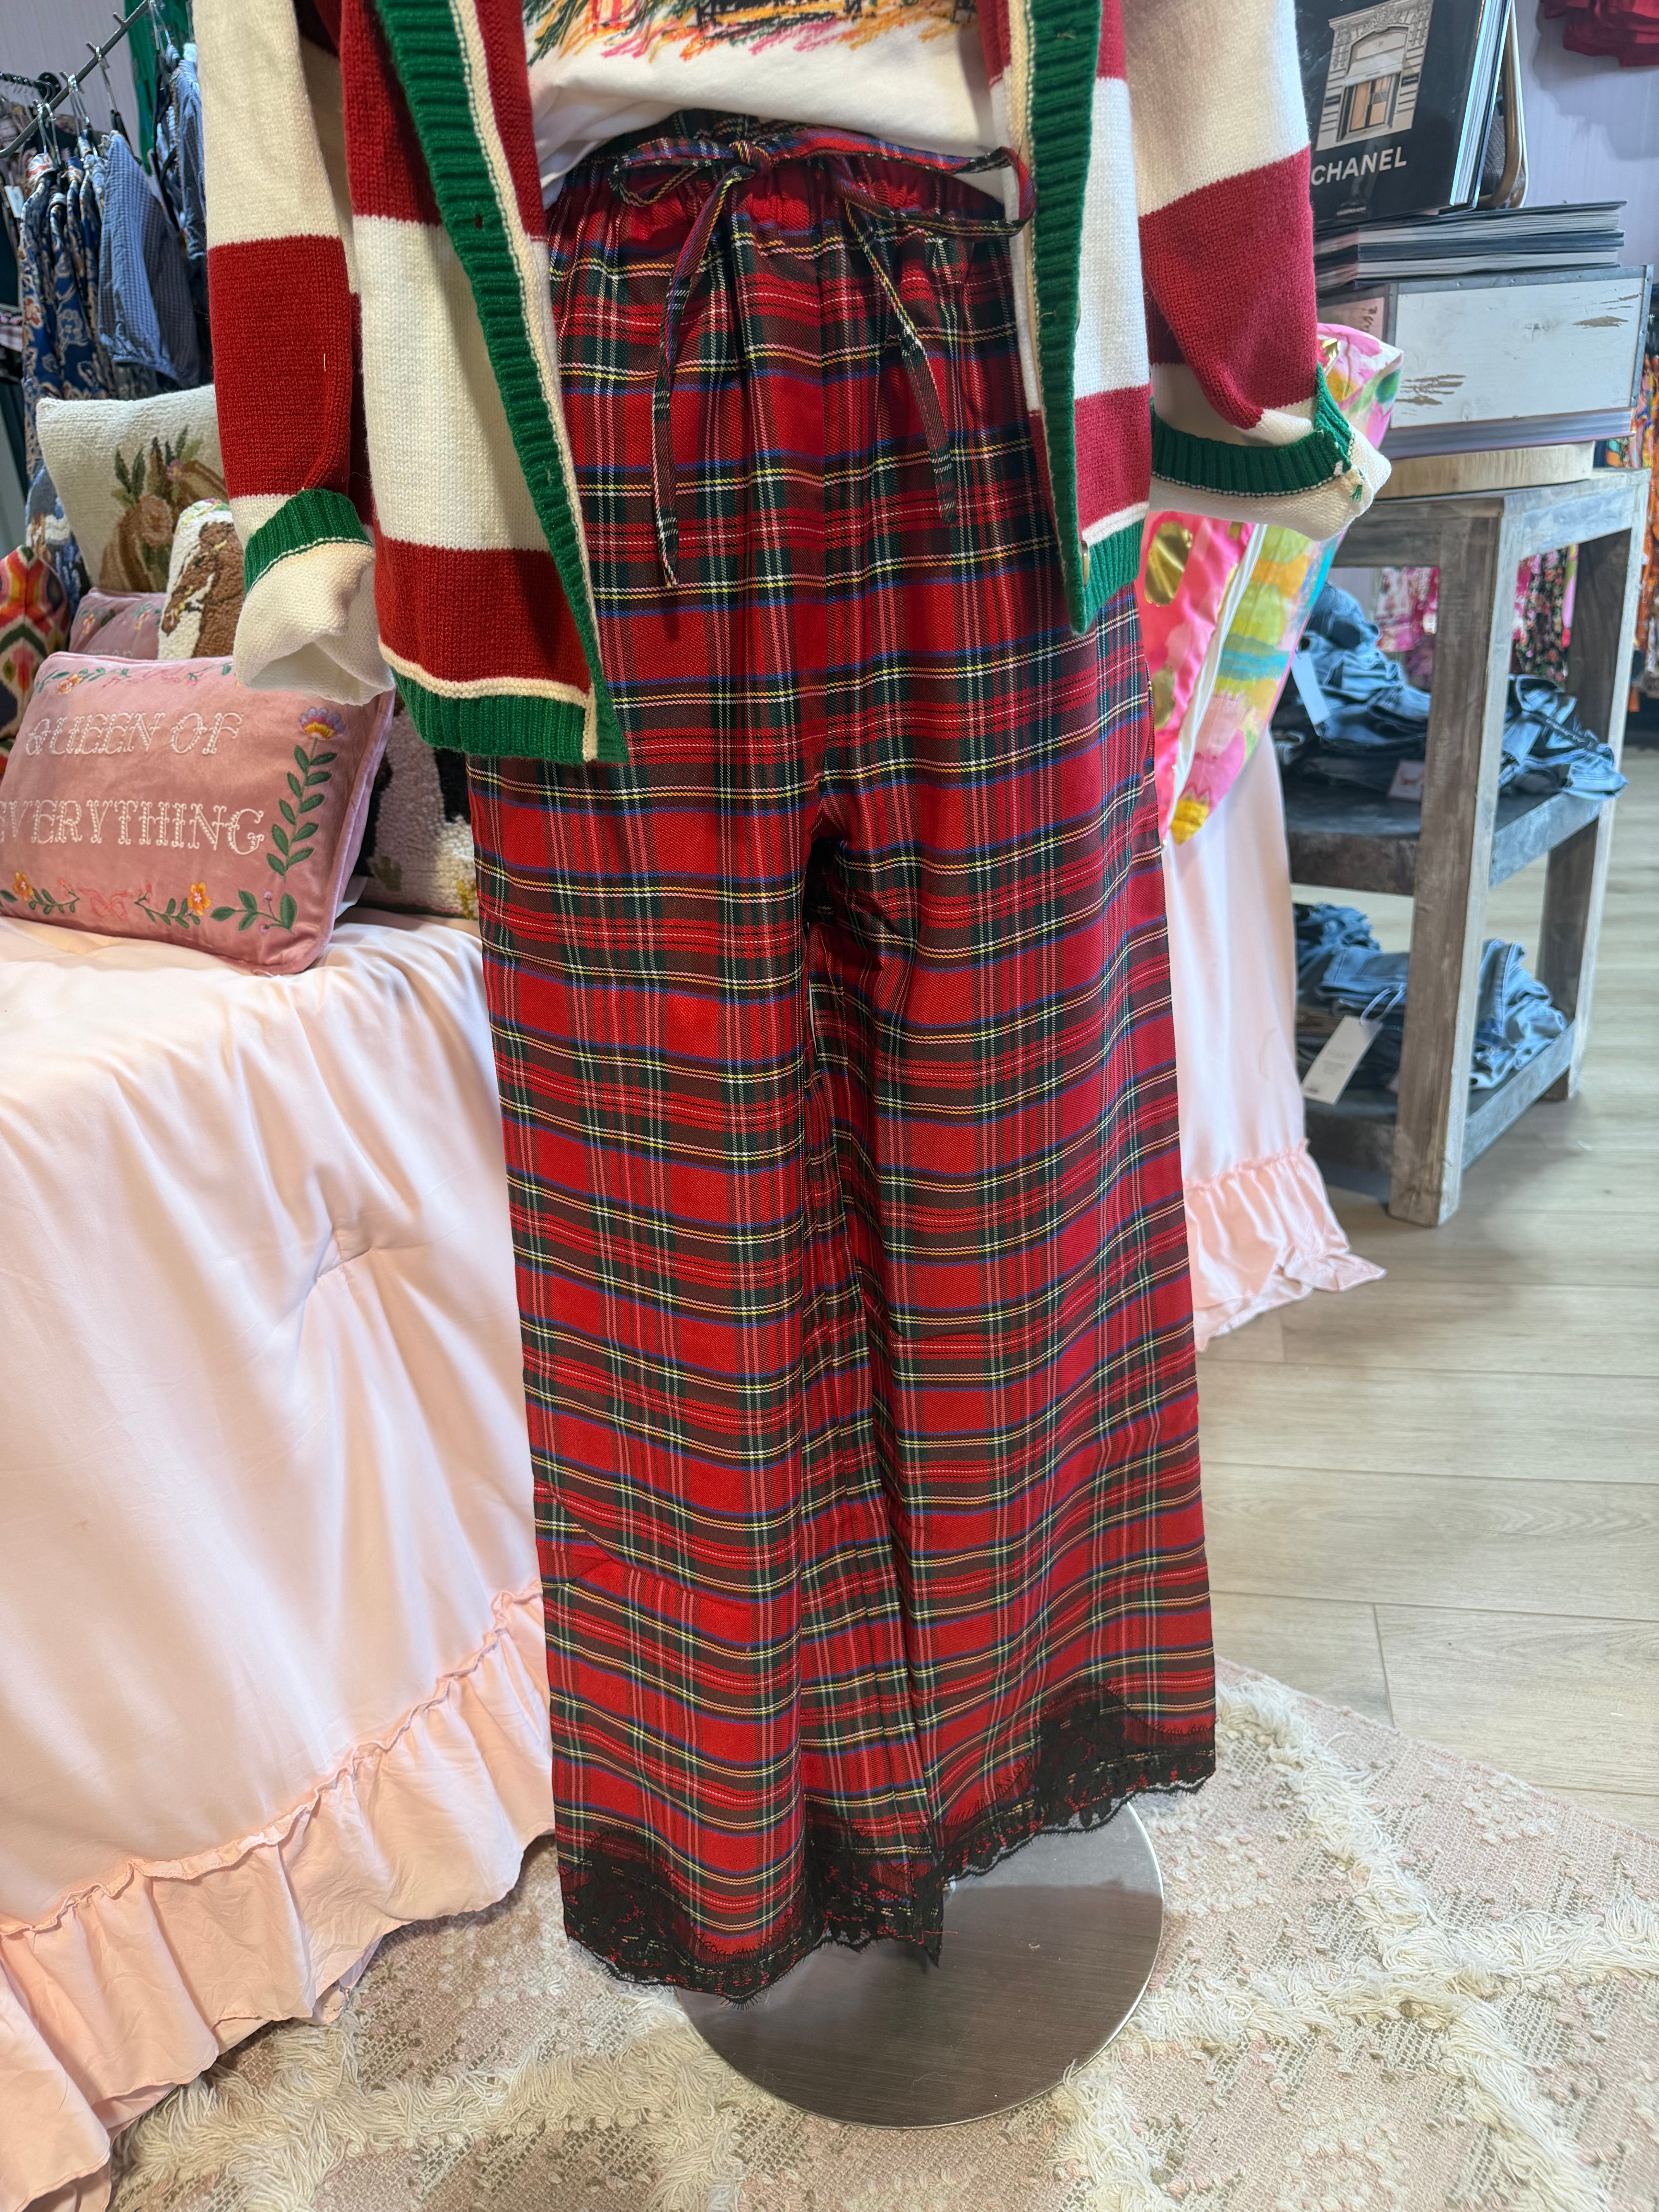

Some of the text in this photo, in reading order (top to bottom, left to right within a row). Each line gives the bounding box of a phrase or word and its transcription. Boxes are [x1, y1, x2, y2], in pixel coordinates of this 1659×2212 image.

[1310, 146, 1407, 186] CHANEL
[26, 712, 244, 756] QUEEN OF
